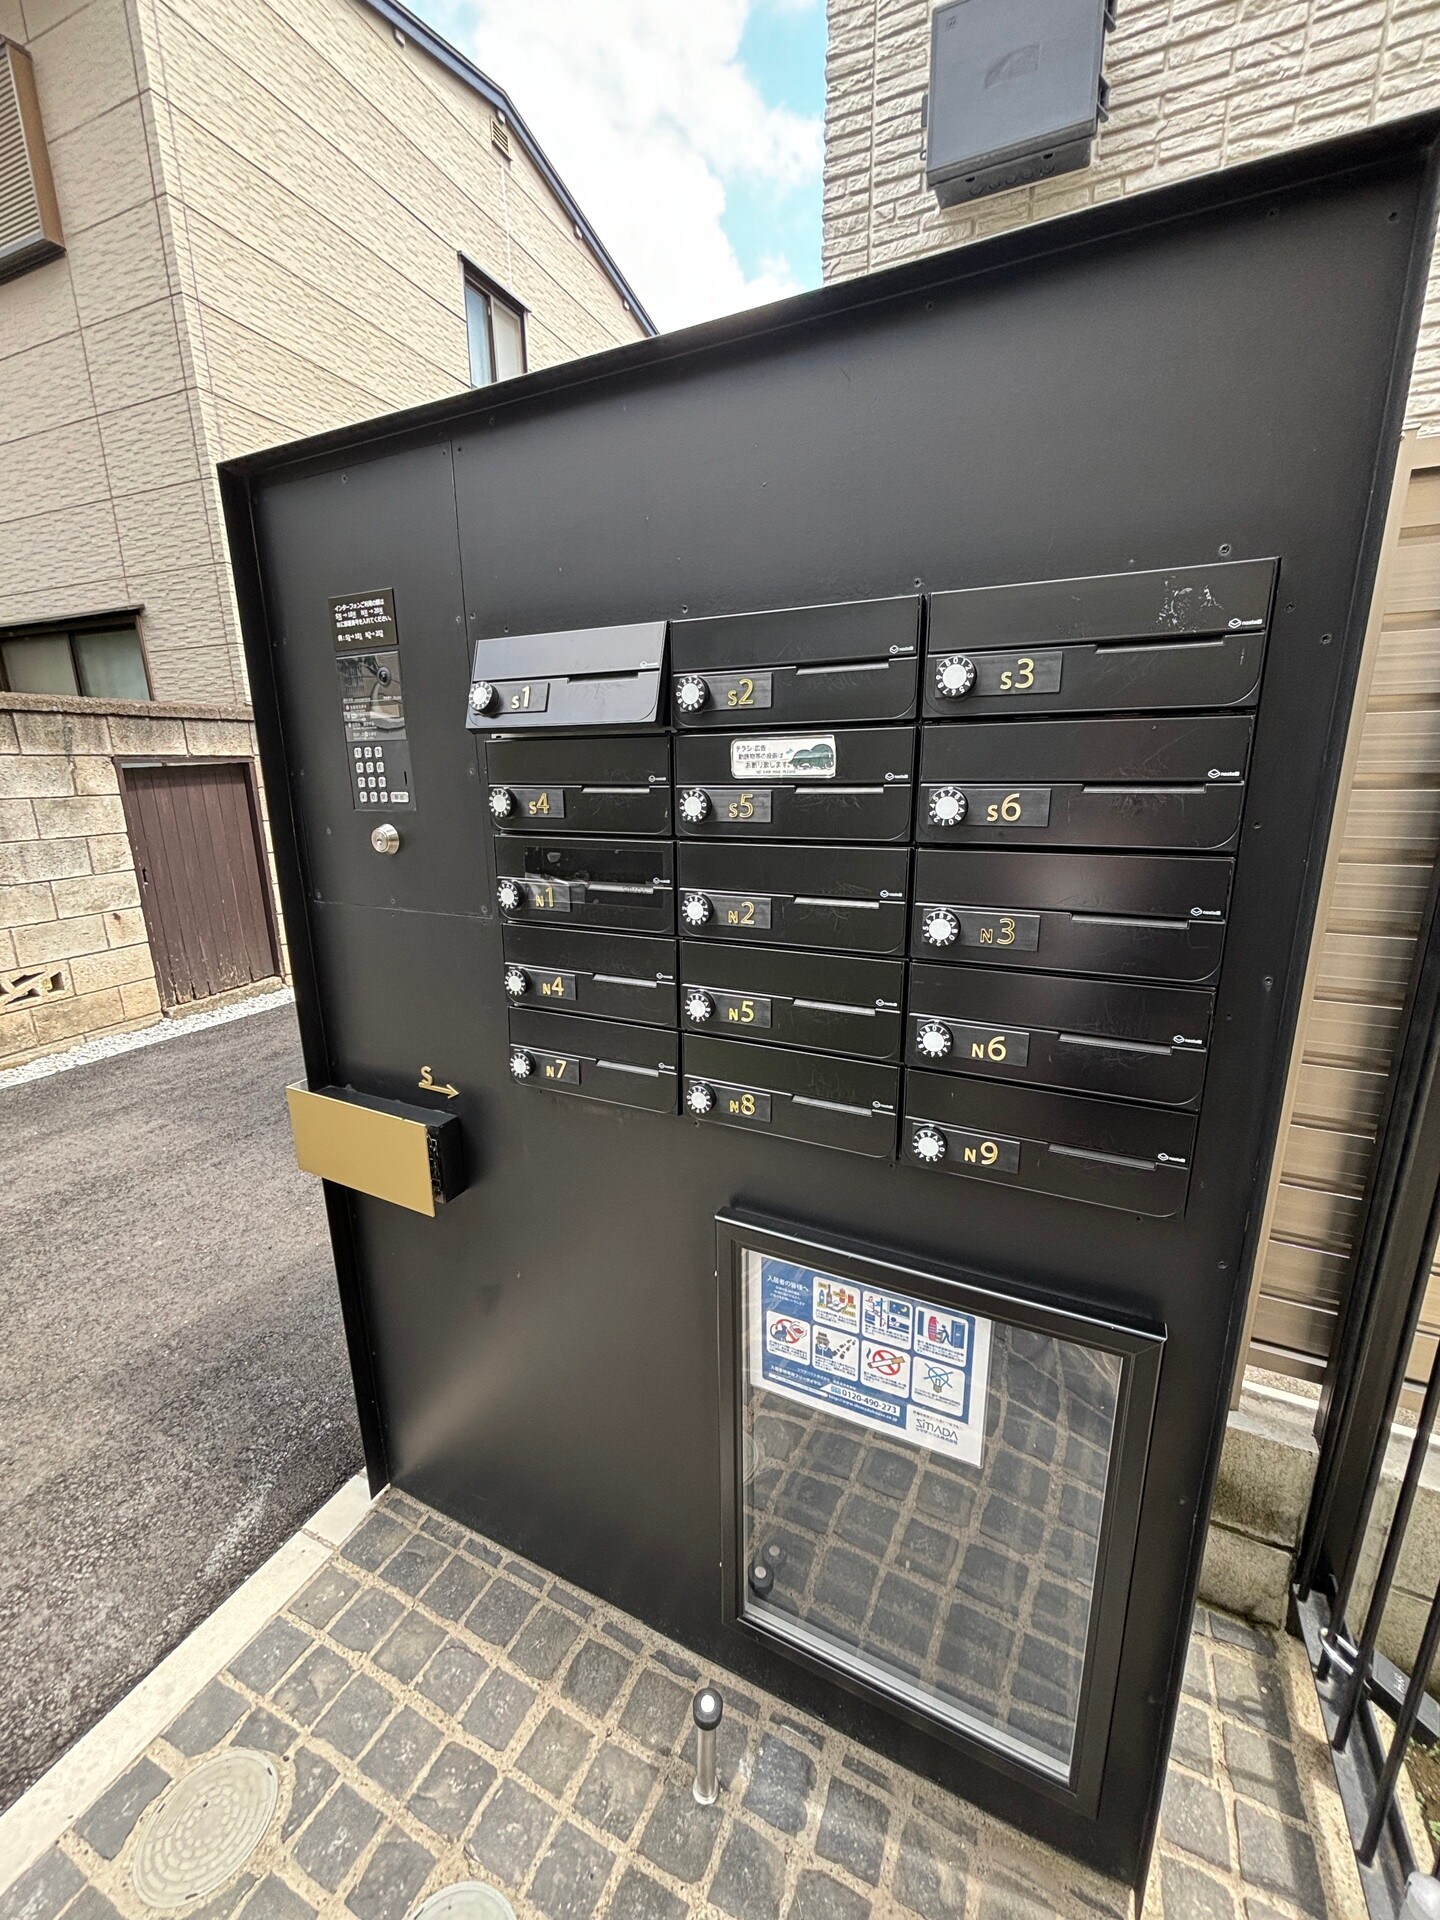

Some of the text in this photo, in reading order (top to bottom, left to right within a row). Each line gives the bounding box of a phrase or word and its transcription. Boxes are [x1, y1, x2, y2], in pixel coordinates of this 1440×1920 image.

[535, 887, 554, 908] N1
[728, 901, 755, 925] N2
[980, 918, 1015, 945] N3
[543, 976, 564, 997] N4
[728, 1001, 754, 1023] N5
[971, 1036, 1007, 1061] N6
[420, 1066, 433, 1086] S
[546, 1059, 567, 1079] N7
[729, 1094, 756, 1116] N8
[964, 1142, 998, 1165] N9
[842, 1389, 897, 1414] 0120-490-273
